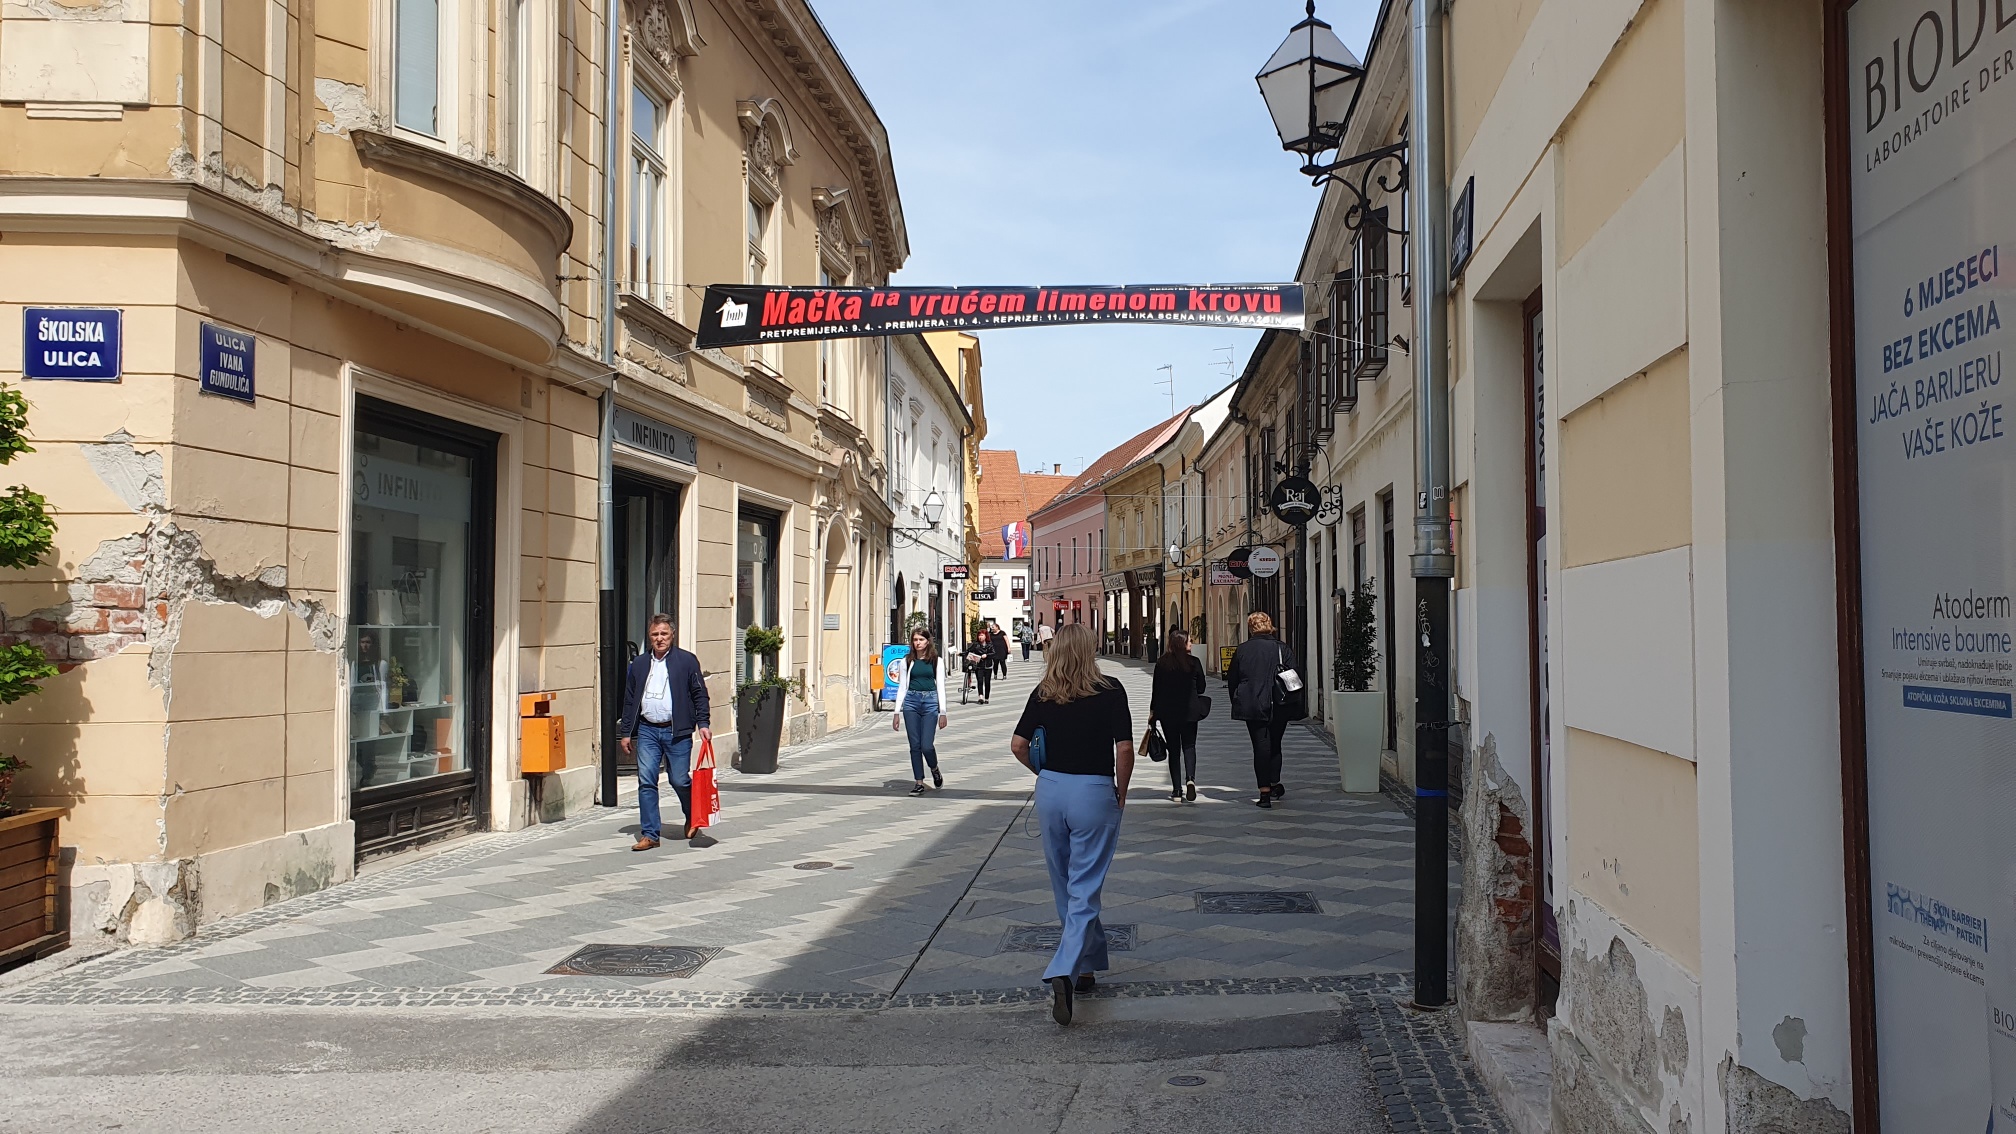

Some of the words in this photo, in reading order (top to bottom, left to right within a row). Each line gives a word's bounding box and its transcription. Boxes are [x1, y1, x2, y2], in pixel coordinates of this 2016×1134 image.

[1866, 80, 1971, 173] LABORATOIRE
[1904, 287, 1914, 318] 6
[1919, 244, 1998, 312] MJESECI
[761, 291, 862, 326] Mačka
[871, 293, 900, 307] na
[910, 290, 1025, 316] vrućem
[1037, 290, 1175, 311] limenom
[1188, 289, 1282, 313] krovu
[38, 317, 105, 342] ŠKOLSKA
[760, 325, 849, 339] PRETPREMIJERA:
[852, 324, 862, 332] 9.
[885, 319, 949, 329] PREMIJERA:
[953, 318, 968, 326] 10.
[993, 314, 1042, 324] REPRIZE:
[1114, 312, 1154, 320] VELIKA
[1199, 314, 1223, 322] HNK
[1883, 334, 1914, 374] BEZ
[1918, 299, 2001, 361] EKCEMA
[215, 332, 247, 353] ULICA
[43, 350, 102, 367] ULICA
[219, 351, 244, 372] IVANA
[209, 368, 250, 394] GUNDULIĆA
[1869, 381, 1911, 425] JAČA
[1915, 350, 2001, 410] BARIJERU
[632, 421, 675, 454] INFINITO
[1902, 416, 1946, 461] VAŠE
[1950, 400, 2004, 450] KOŽE
[1285, 488, 1305, 503] Raj
[1932, 588, 2011, 620] Atoderm
[1892, 626, 1951, 651] Intensive
[1955, 625, 2012, 653] baume
[1933, 692, 1949, 704] KOŽA
[1949, 696, 1973, 706] SKLONA
[1973, 698, 2007, 710] EKCEMIMA
[1951, 909, 1982, 931] BARRIER
[1956, 927, 1983, 946] PATENT
[1962, 969, 1985, 986] ekcema
